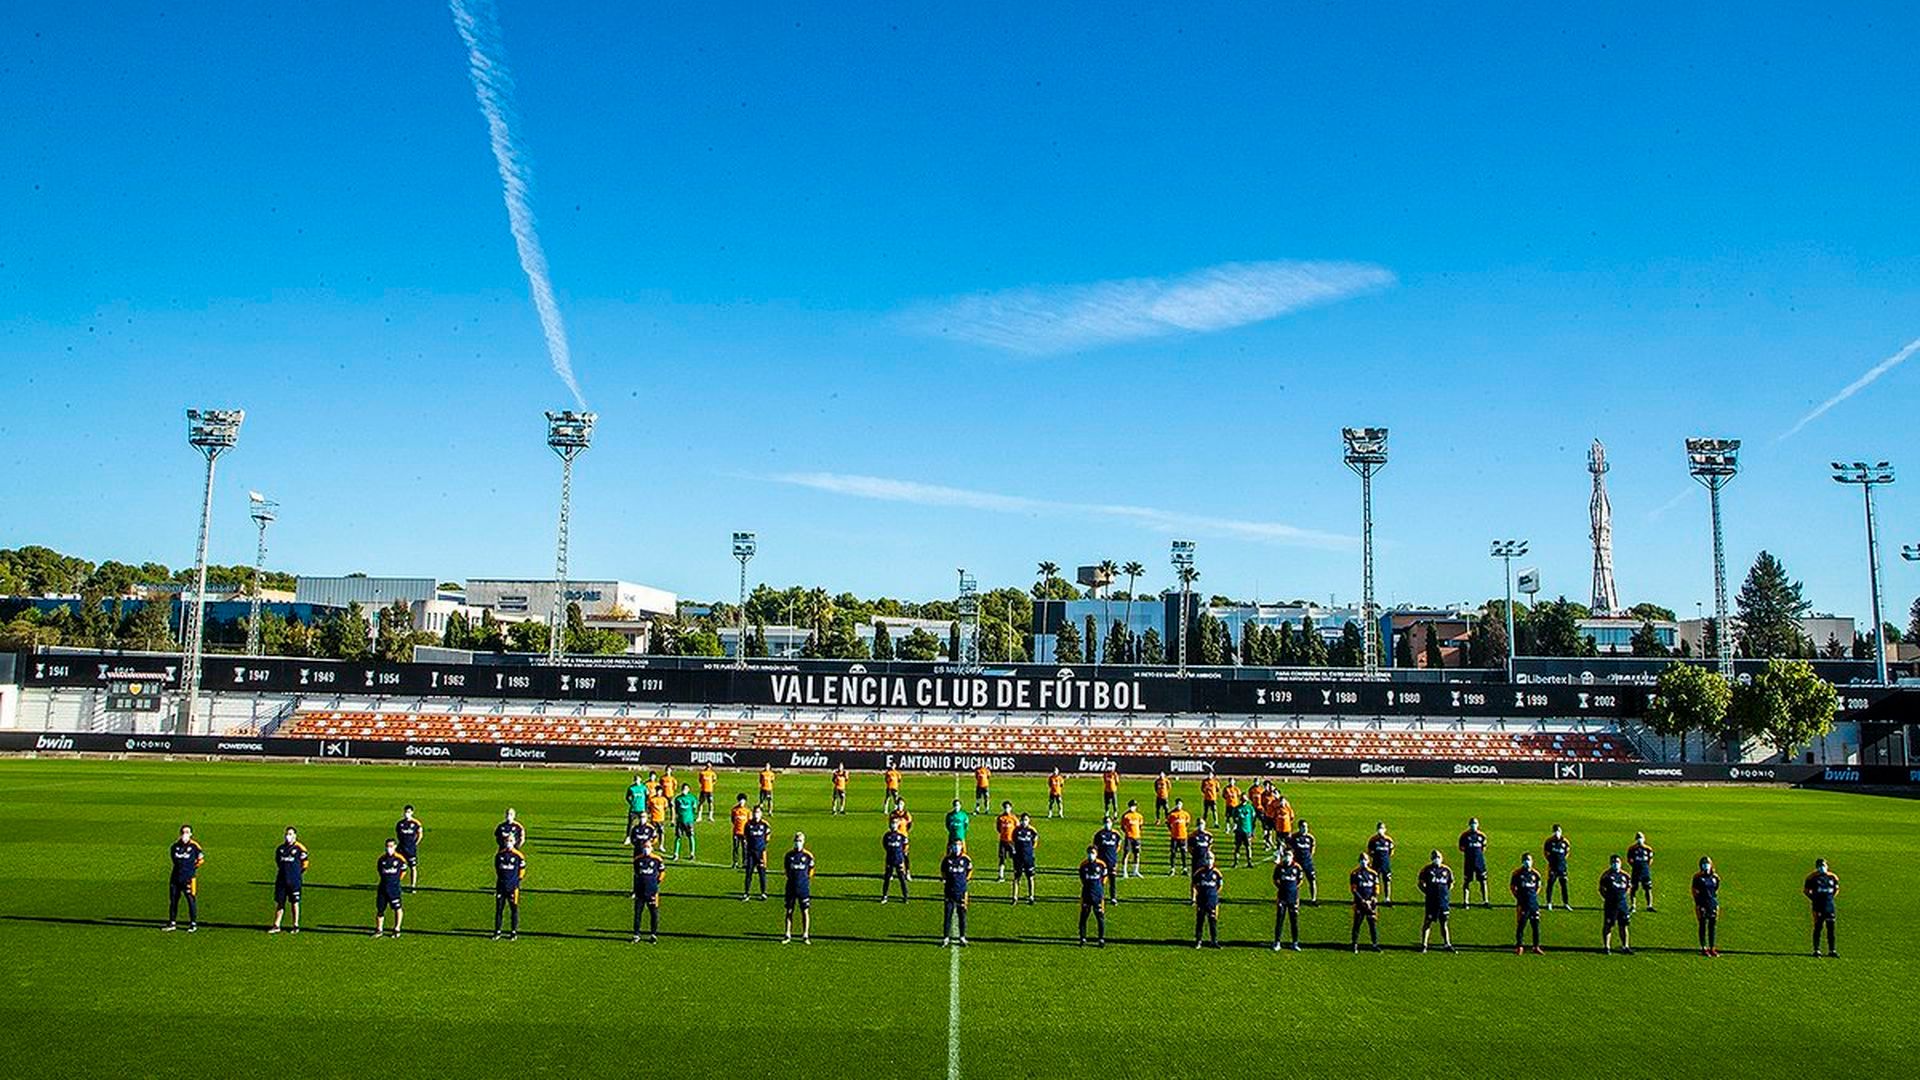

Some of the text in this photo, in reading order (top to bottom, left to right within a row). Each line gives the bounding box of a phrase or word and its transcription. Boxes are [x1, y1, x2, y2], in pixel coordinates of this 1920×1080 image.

[49, 665, 69, 677] 1941
[248, 669, 270, 681] 1947
[313, 671, 335, 683] 1949
[378, 672, 400, 685] 1954
[1528, 673, 1567, 685] Libertex
[642, 679, 664, 691] 1971
[770, 674, 1147, 710] VALENCIA CLUB DE FÚTBOL
[1270, 691, 1293, 702] 1979
[1335, 691, 1358, 704] 1980
[1463, 693, 1485, 705] 1999
[1526, 694, 1548, 706] 1999
[1594, 695, 1616, 708] 2002
[36, 735, 75, 749] bwin
[405, 744, 451, 756] ŠKODA
[509, 748, 546, 759] Libertex
[690, 751, 725, 764] PUMA
[789, 751, 829, 767] bwin
[899, 755, 951, 769] ANTONIO
[1170, 760, 1204, 772] PUMA
[1369, 763, 1405, 774] Libertex
[1453, 763, 1499, 774] ŠKODA
[1823, 767, 1860, 781] bwin
